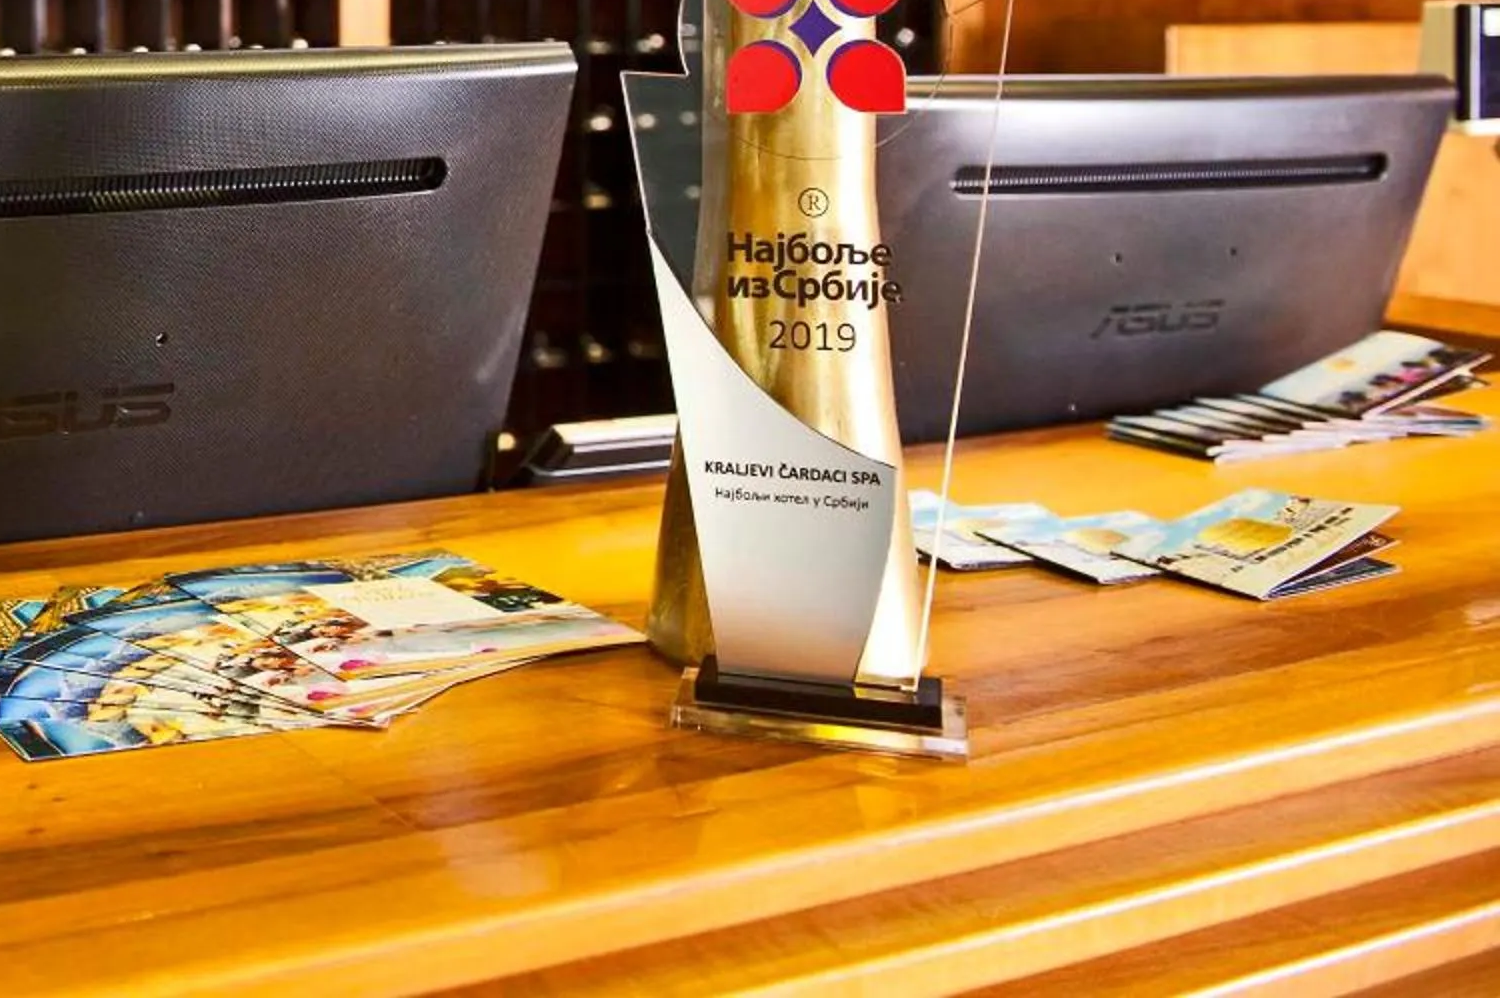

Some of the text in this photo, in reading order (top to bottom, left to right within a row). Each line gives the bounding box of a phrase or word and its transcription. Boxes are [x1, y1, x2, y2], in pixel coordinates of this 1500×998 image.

[727, 232, 893, 272] Најбоље
[727, 269, 902, 310] из Србије
[769, 320, 857, 352] 2019
[1089, 299, 1226, 340] ASUS
[705, 460, 881, 486] KRALJEVI ČARDACI SPA
[715, 487, 771, 502] Најбољи
[773, 493, 809, 505] хотел
[823, 495, 869, 512] Србији
